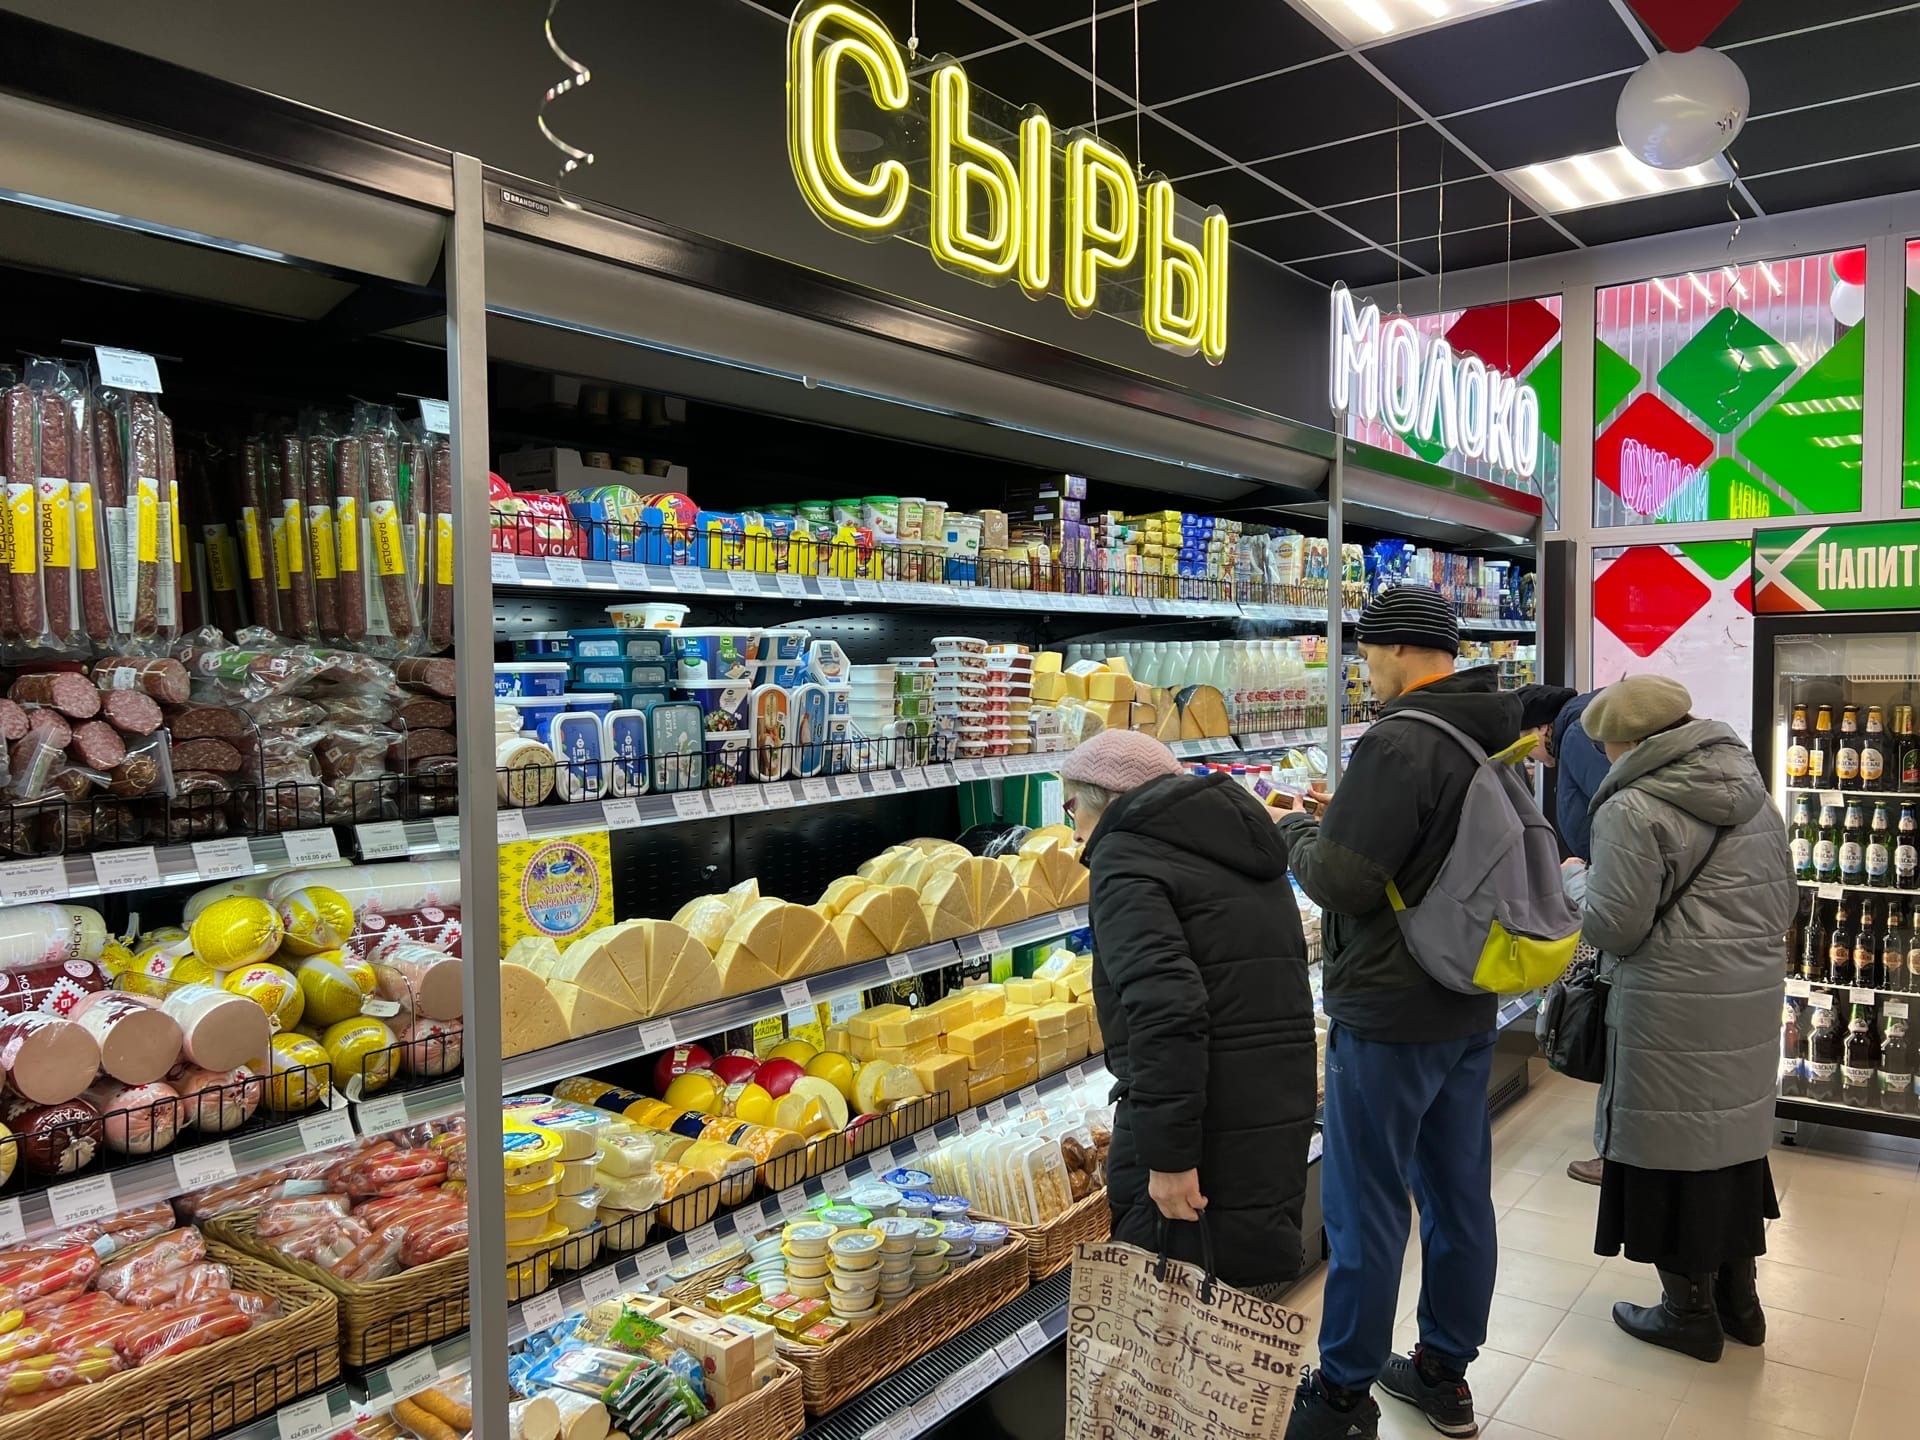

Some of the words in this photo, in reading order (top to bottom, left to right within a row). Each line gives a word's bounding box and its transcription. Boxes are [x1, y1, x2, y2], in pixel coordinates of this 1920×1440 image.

[792, 3, 1229, 358] СЫРЫ
[1331, 288, 1538, 477] МОЛОКО
[43, 503, 54, 563] МЕДОВАЯ
[1818, 542, 1920, 591] НАПИТ
[18, 975, 34, 1011] МОРТА
[1080, 1244, 1129, 1266] Latte
[1079, 1267, 1093, 1302] CAFE
[1133, 1273, 1190, 1309] Mocha
[1190, 1304, 1219, 1326] cafe
[1196, 1279, 1304, 1335] ESPRESSO
[1096, 1321, 1194, 1389] Cappuccino
[1211, 1333, 1243, 1353] drink
[1221, 1318, 1302, 1357] morning
[1251, 1349, 1297, 1378] Hot
[1131, 1368, 1173, 1398] STRONG
[1198, 1380, 1249, 1414] Latte
[1145, 1400, 1197, 1438] DRINK
[1251, 1382, 1271, 1427] milk
